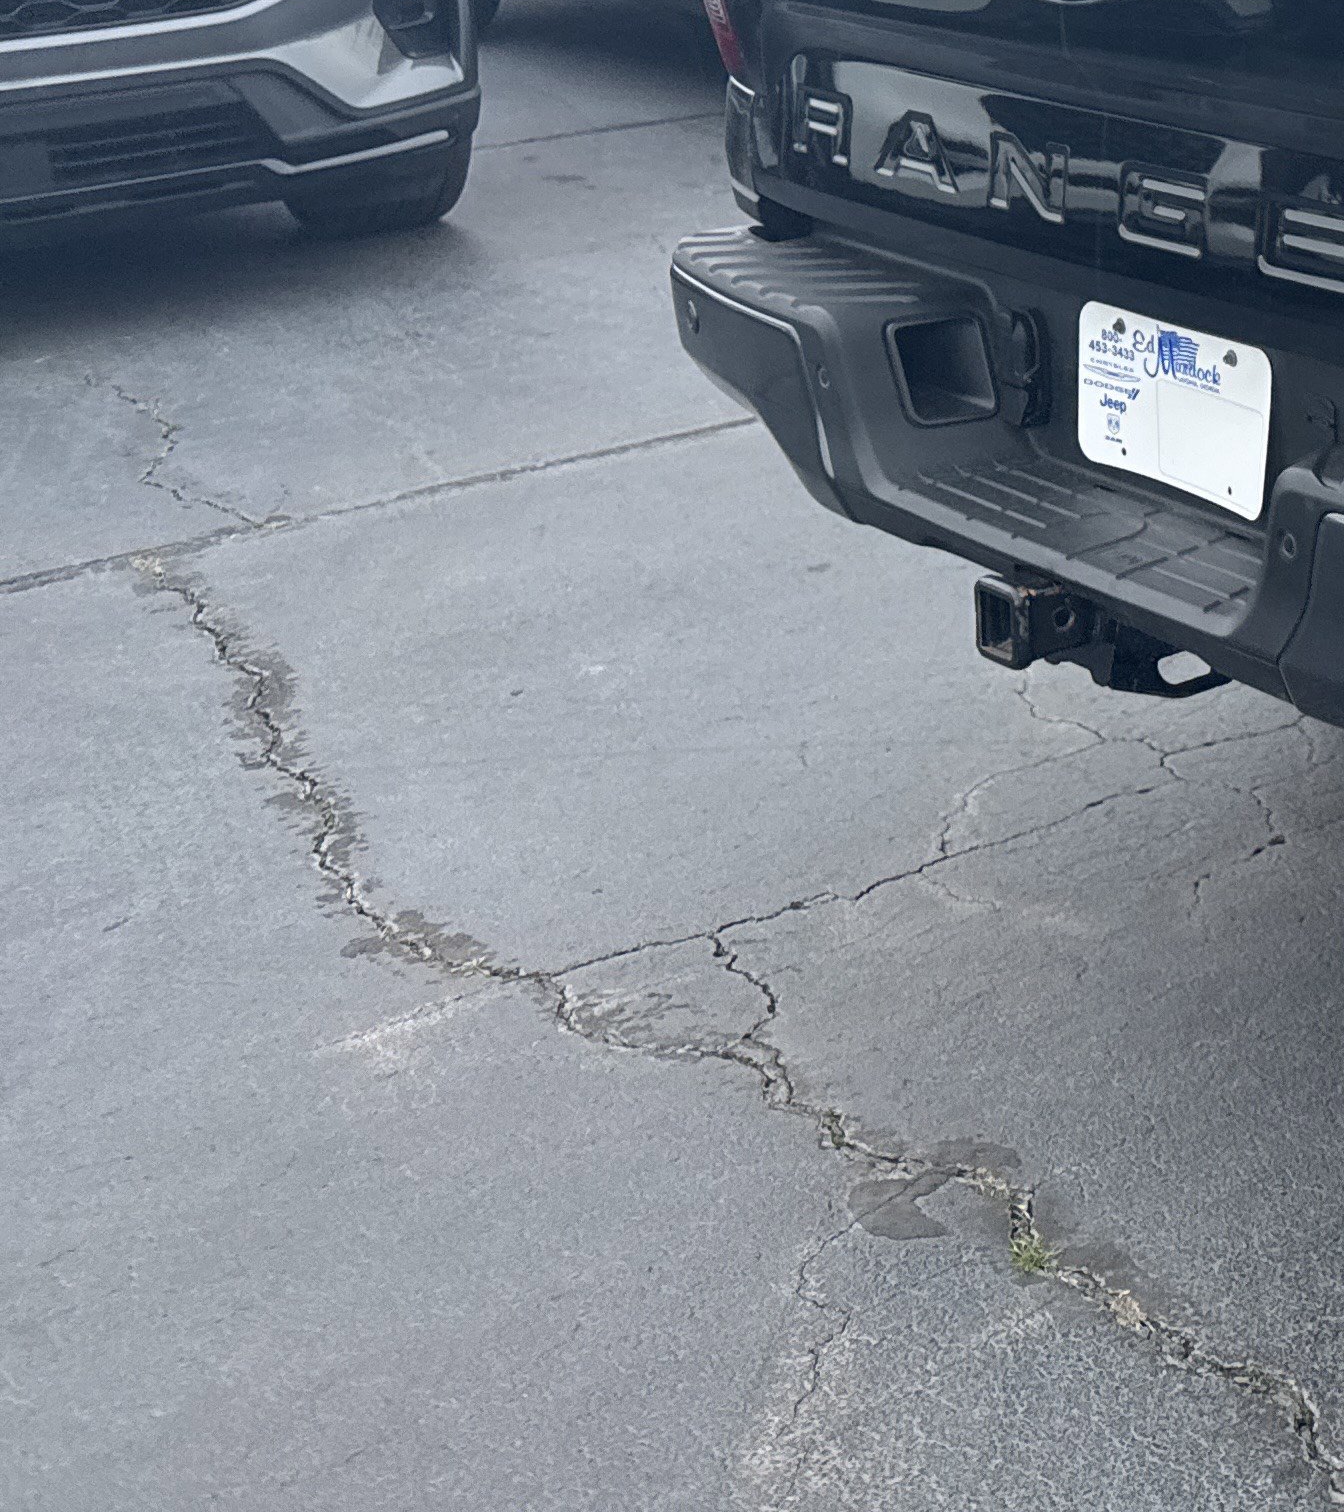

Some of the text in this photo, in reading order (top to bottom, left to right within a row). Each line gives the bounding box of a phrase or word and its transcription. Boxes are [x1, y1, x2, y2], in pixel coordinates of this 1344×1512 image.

[1088, 339, 1135, 361] 453-3433
[1132, 329, 1156, 354] Ed
[1099, 393, 1127, 414] Jeep
